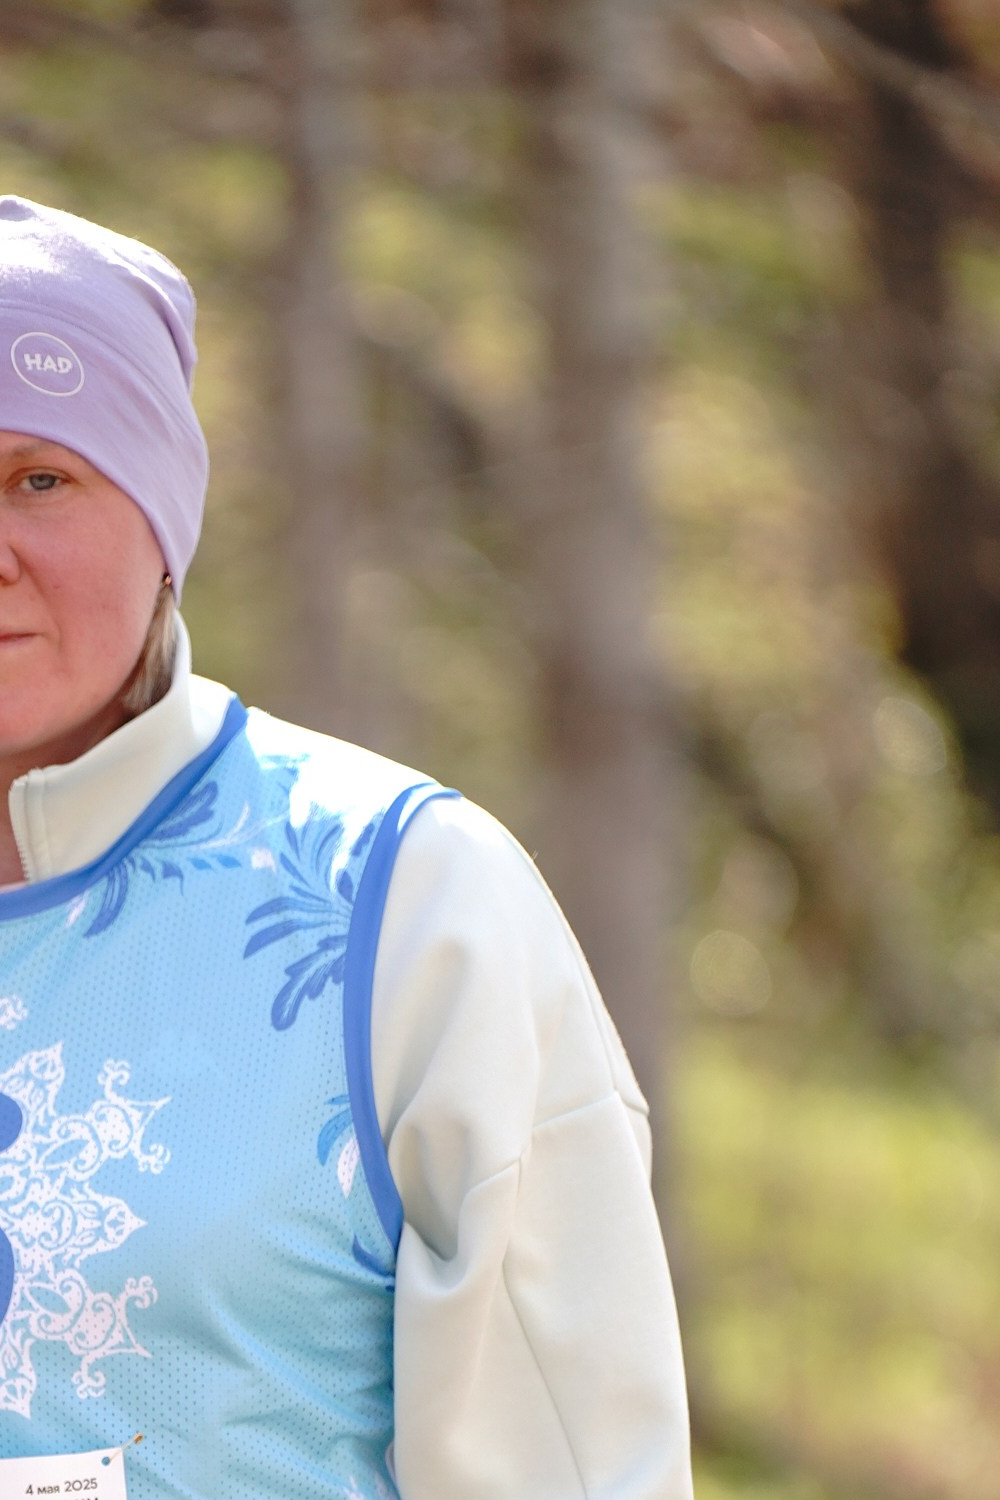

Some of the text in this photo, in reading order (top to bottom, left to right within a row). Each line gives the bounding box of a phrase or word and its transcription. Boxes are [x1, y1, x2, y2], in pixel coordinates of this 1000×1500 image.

[24, 353, 73, 374] HAD
[25, 1478, 98, 1496] 4 мая 2025
